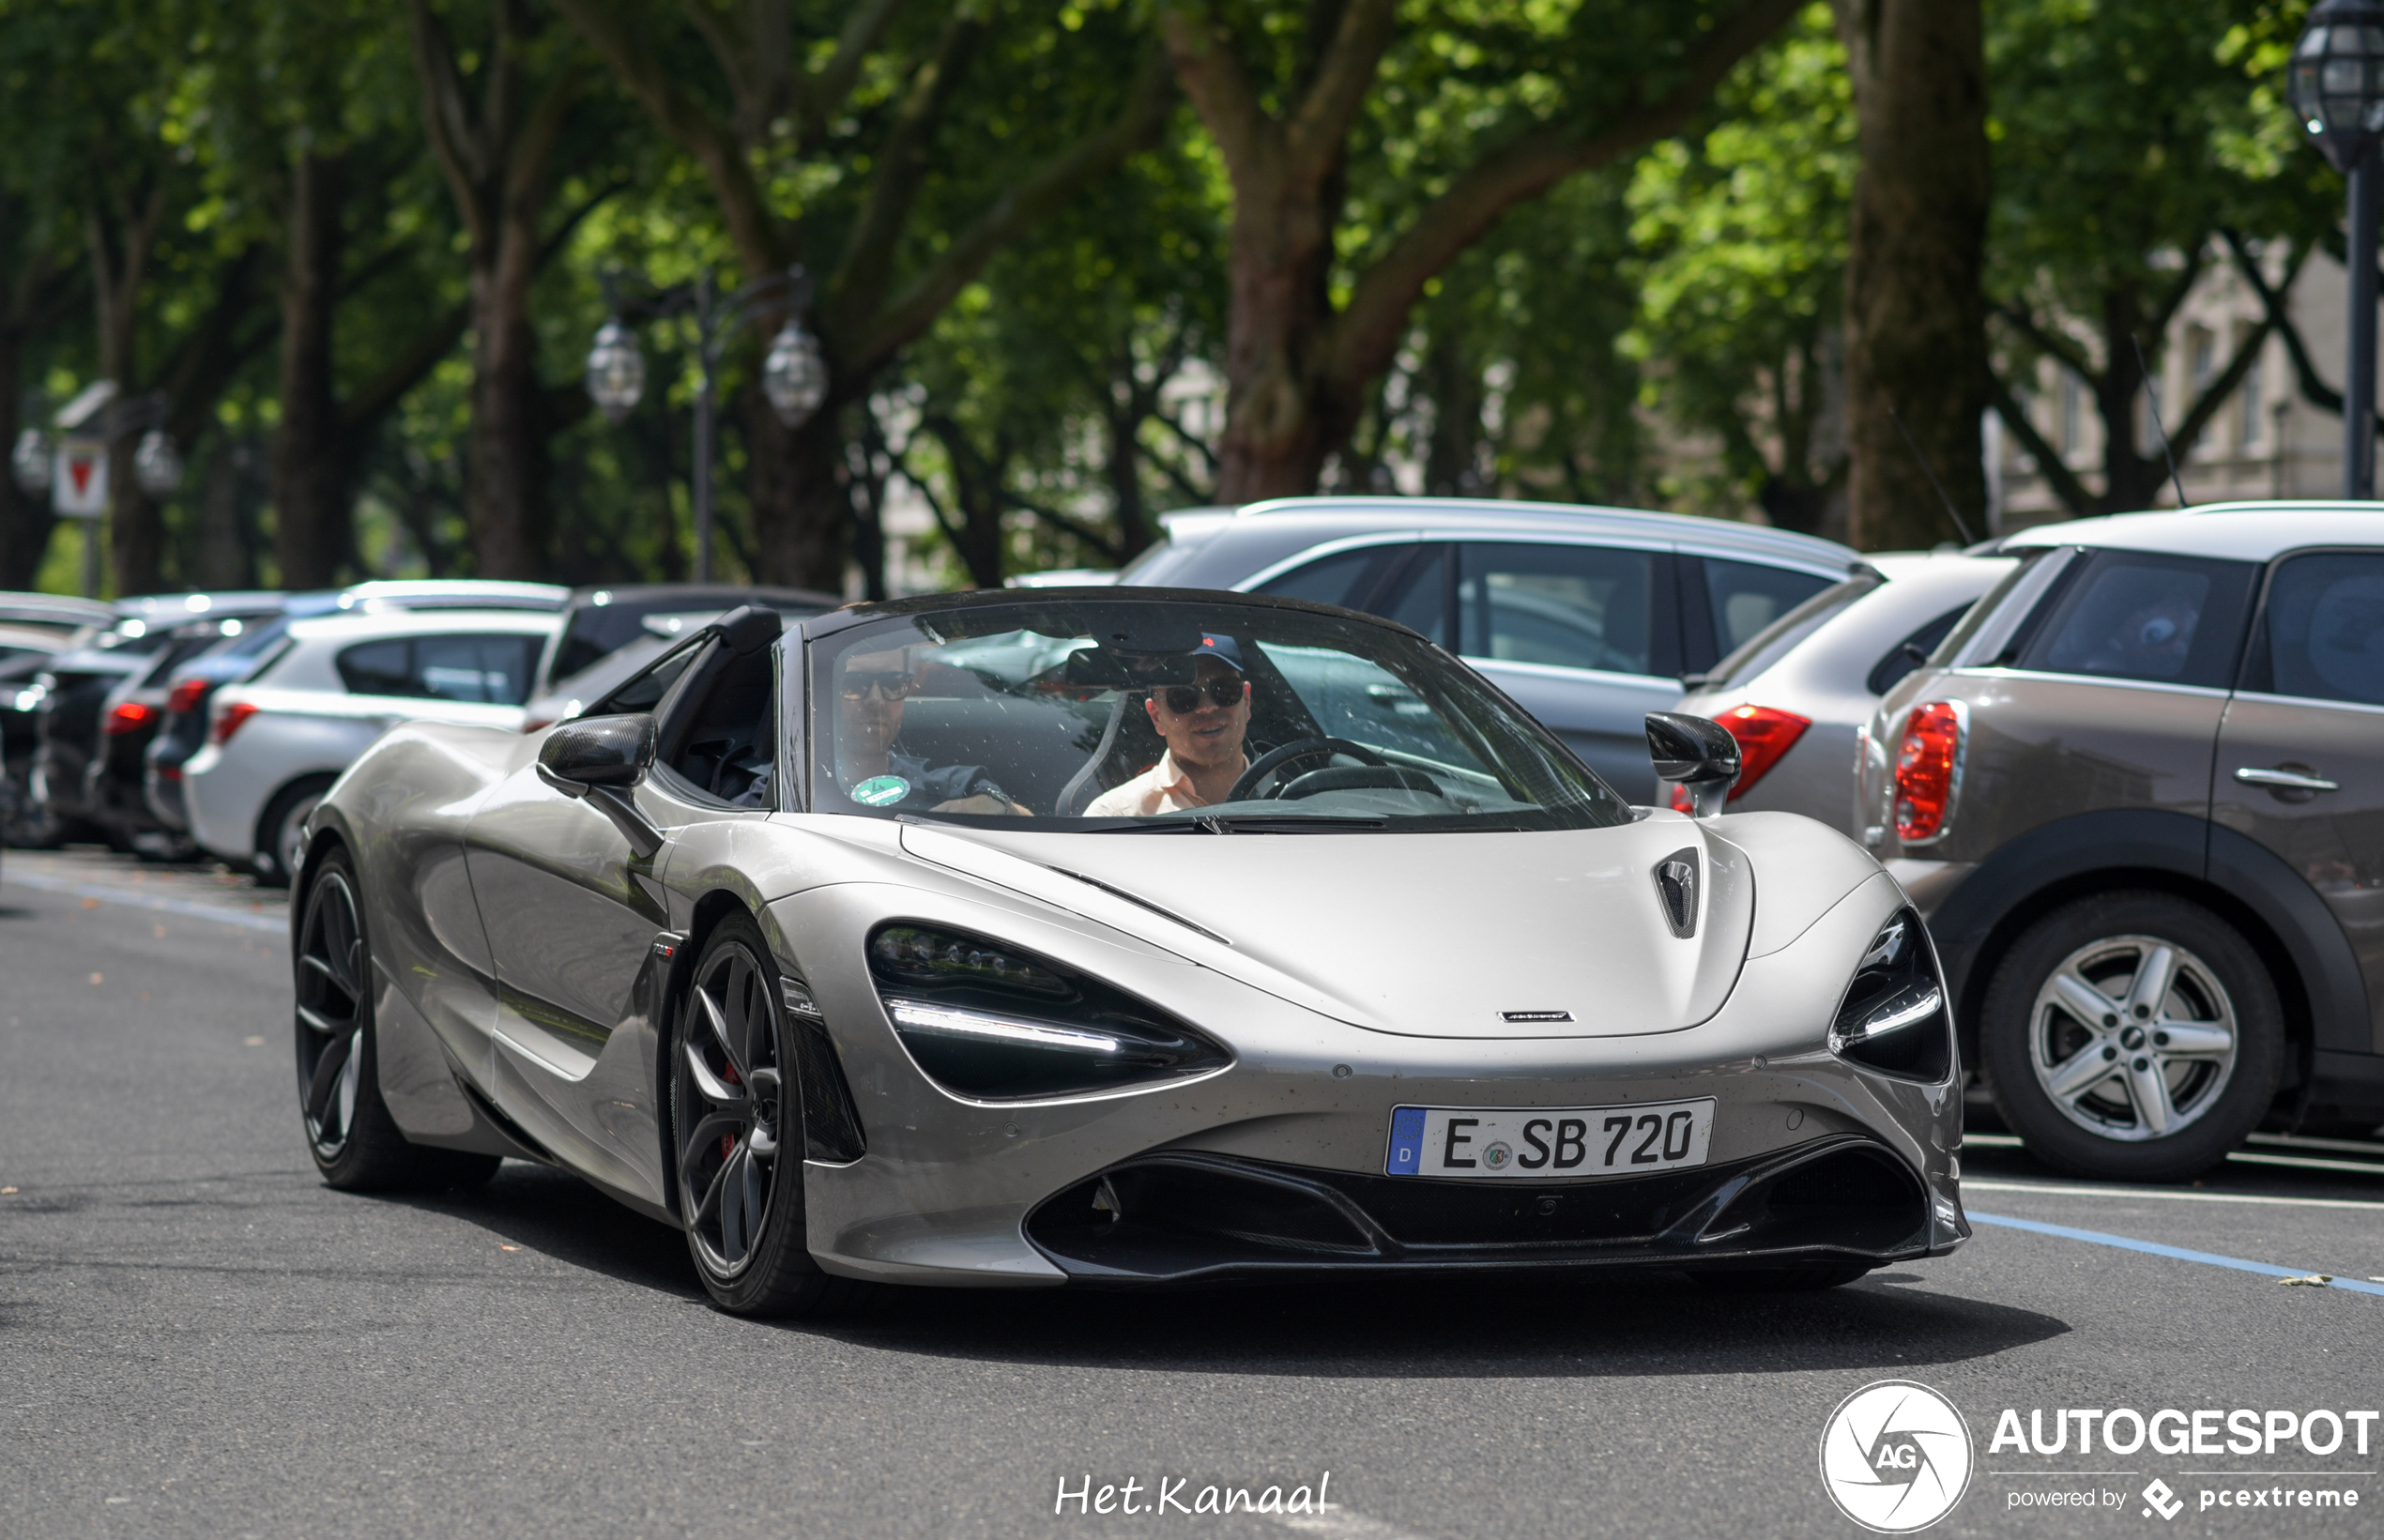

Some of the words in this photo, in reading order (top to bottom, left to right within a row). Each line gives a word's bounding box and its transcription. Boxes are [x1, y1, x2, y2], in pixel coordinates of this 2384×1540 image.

[1398, 1148, 1412, 1163] D
[1443, 1118, 1480, 1168] E
[1518, 1118, 1587, 1169] SB
[1603, 1109, 1693, 1166] 720
